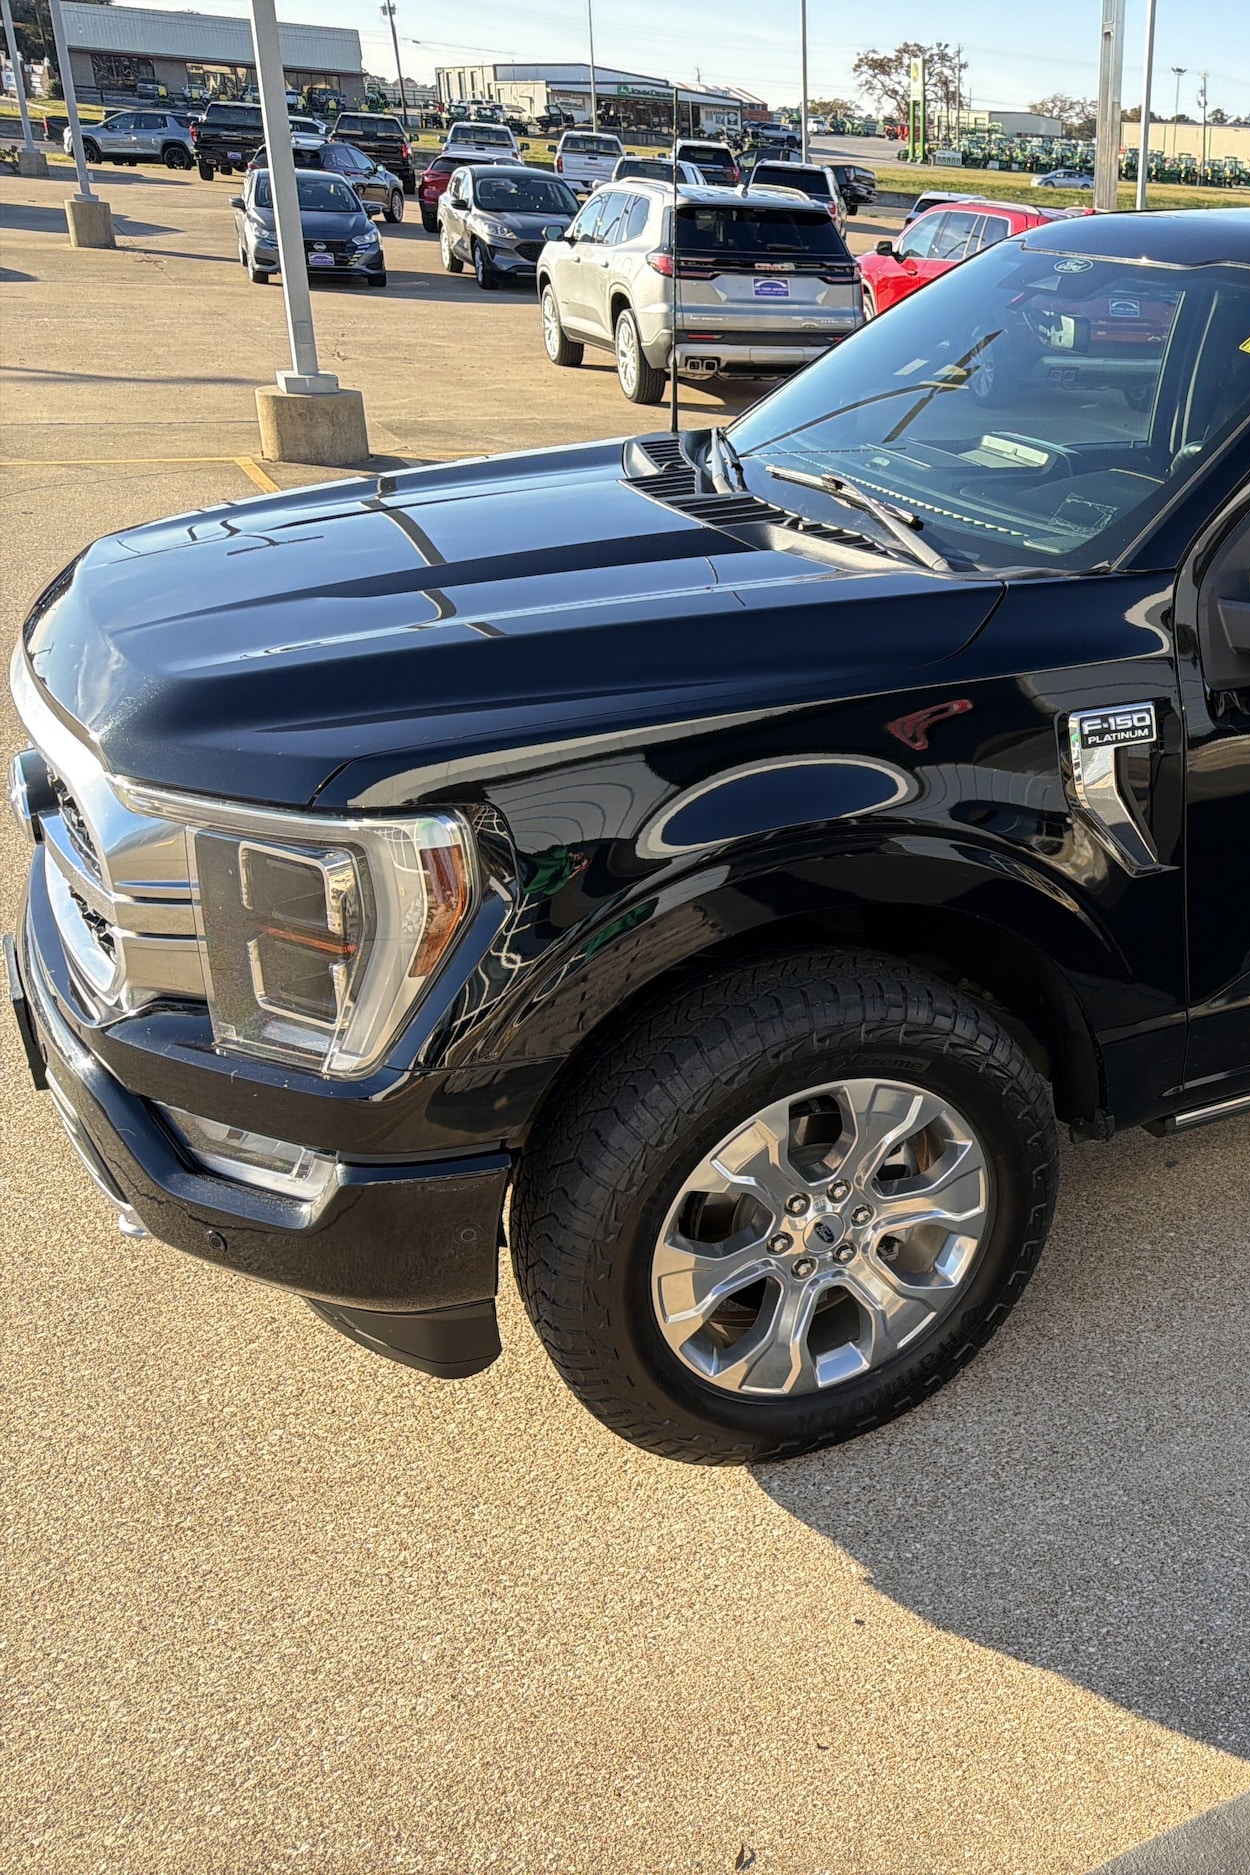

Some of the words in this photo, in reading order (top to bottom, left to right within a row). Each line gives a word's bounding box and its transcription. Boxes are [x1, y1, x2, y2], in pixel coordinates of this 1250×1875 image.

[754, 263, 796, 271] GMC
[1082, 712, 1151, 735] F-150
[1088, 728, 1149, 745] PLATINUM
[815, 1223, 835, 1243] Ford
